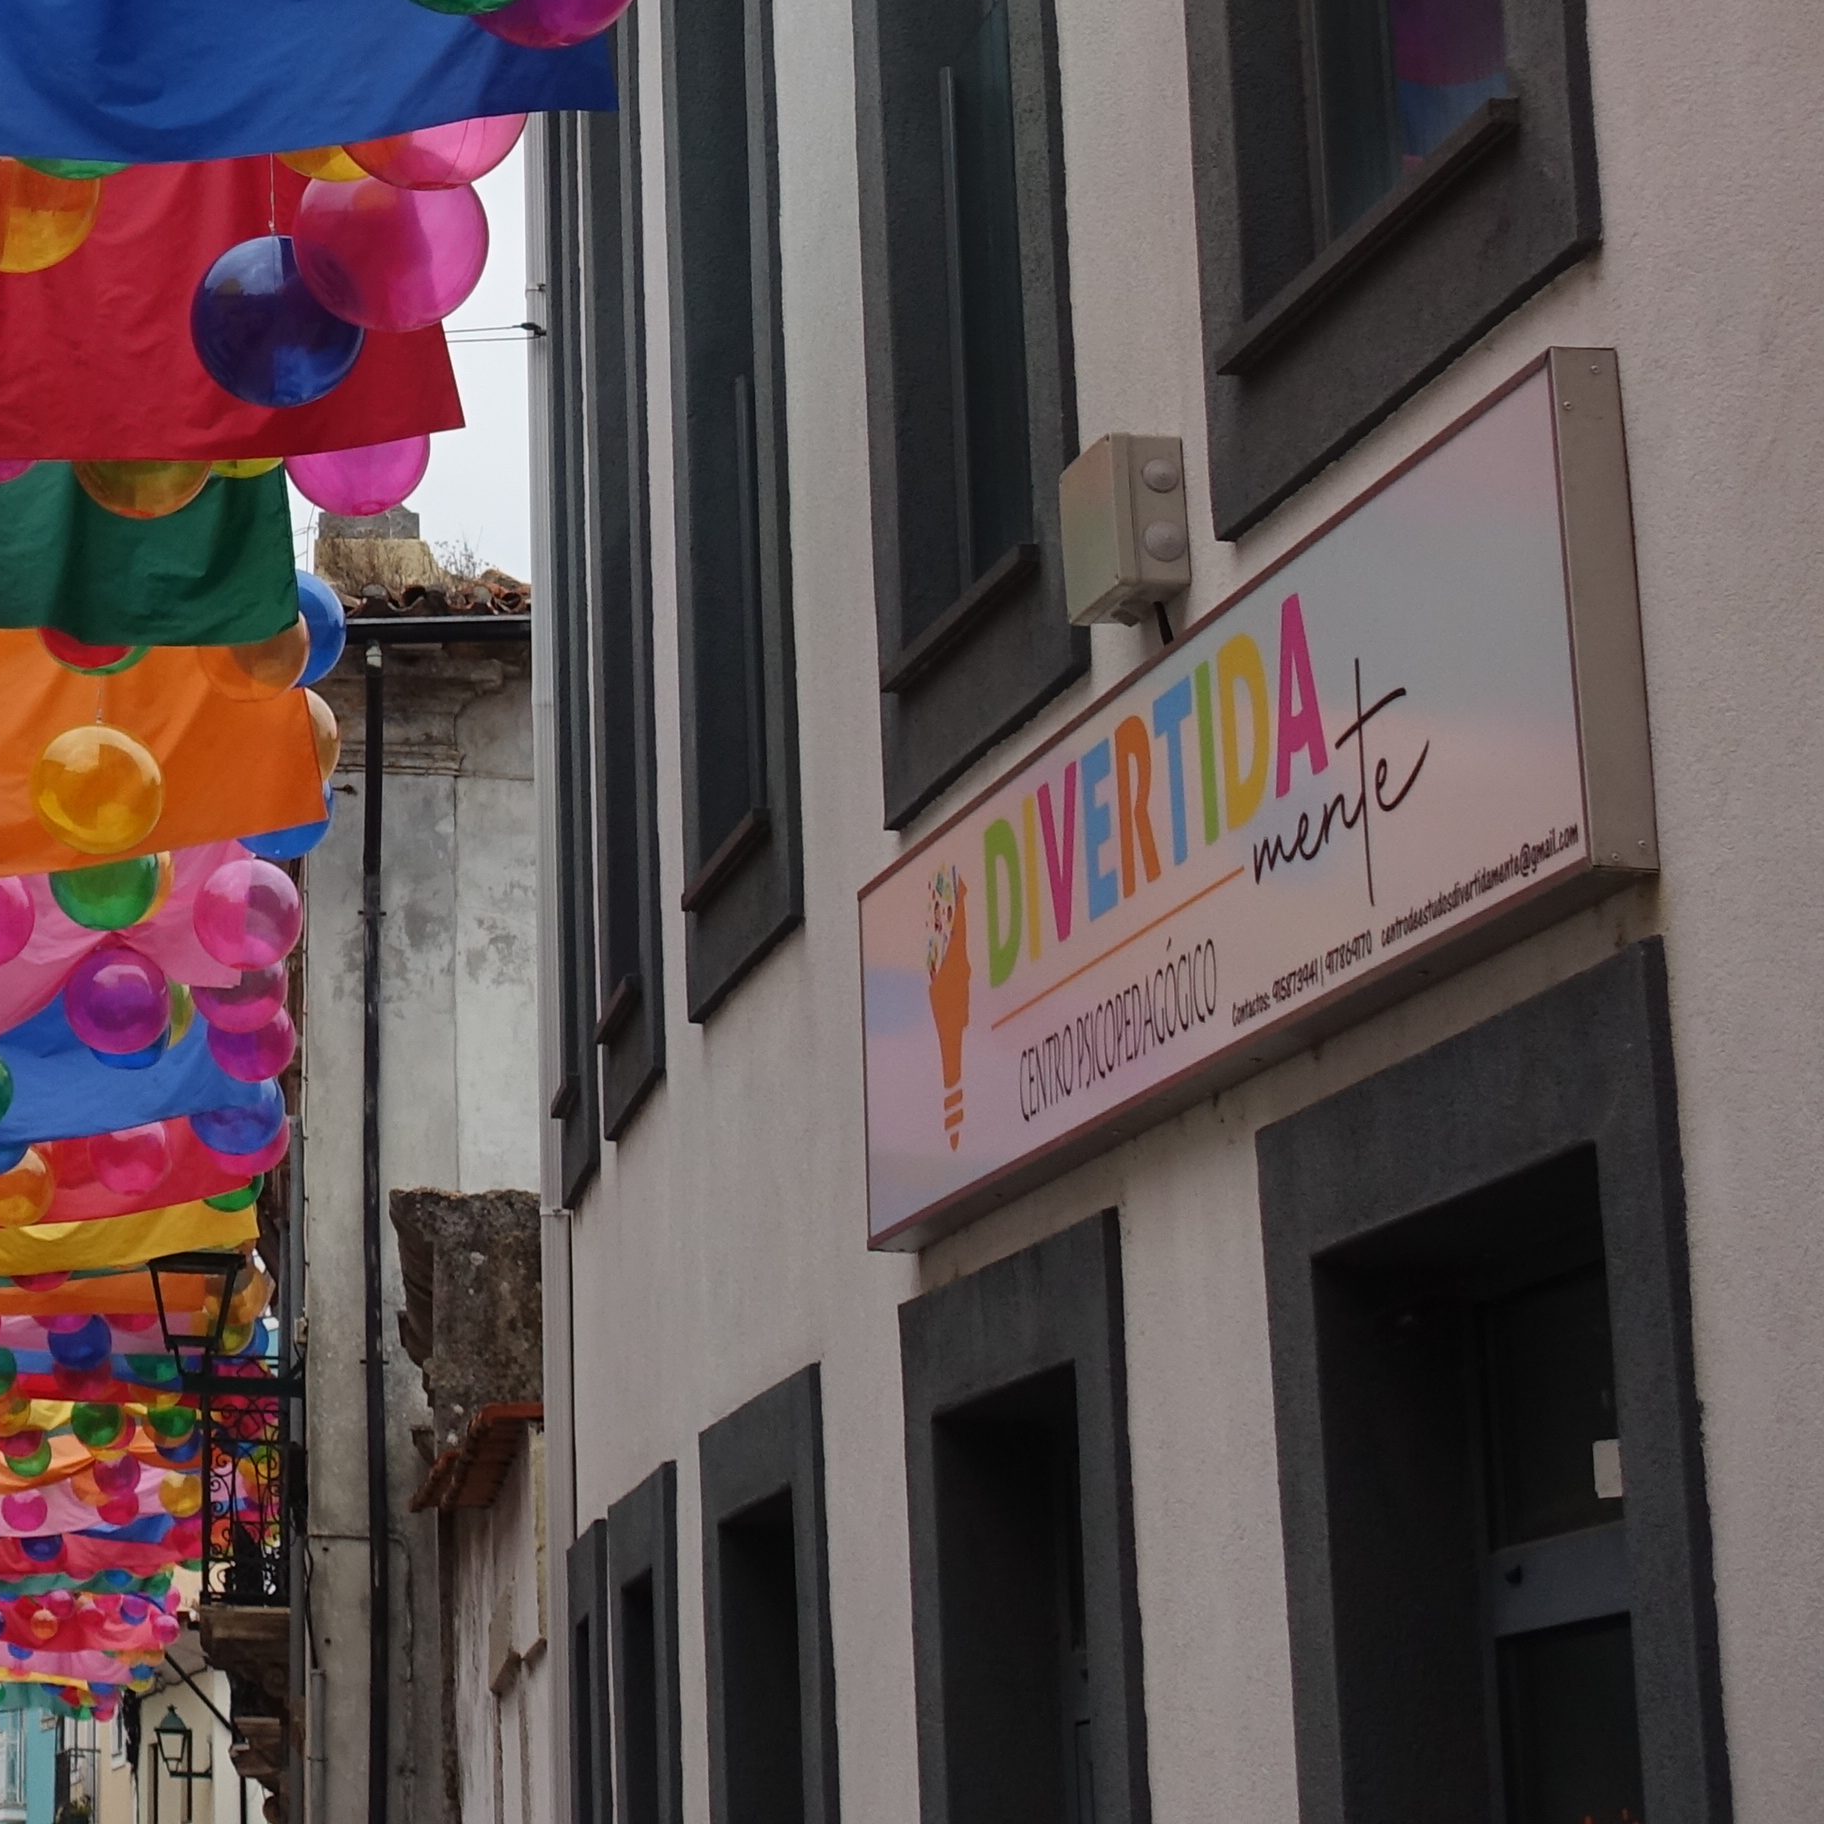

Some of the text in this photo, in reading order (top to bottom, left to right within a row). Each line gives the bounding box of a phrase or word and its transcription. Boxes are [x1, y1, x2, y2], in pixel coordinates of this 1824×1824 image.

[983, 593, 1328, 988] DIVERTIDA
[1253, 657, 1430, 907] mente
[1019, 936, 1217, 1122] CENTRO PSICOPEDAGÓGICO
[1231, 991, 1271, 1027] Contactos:
